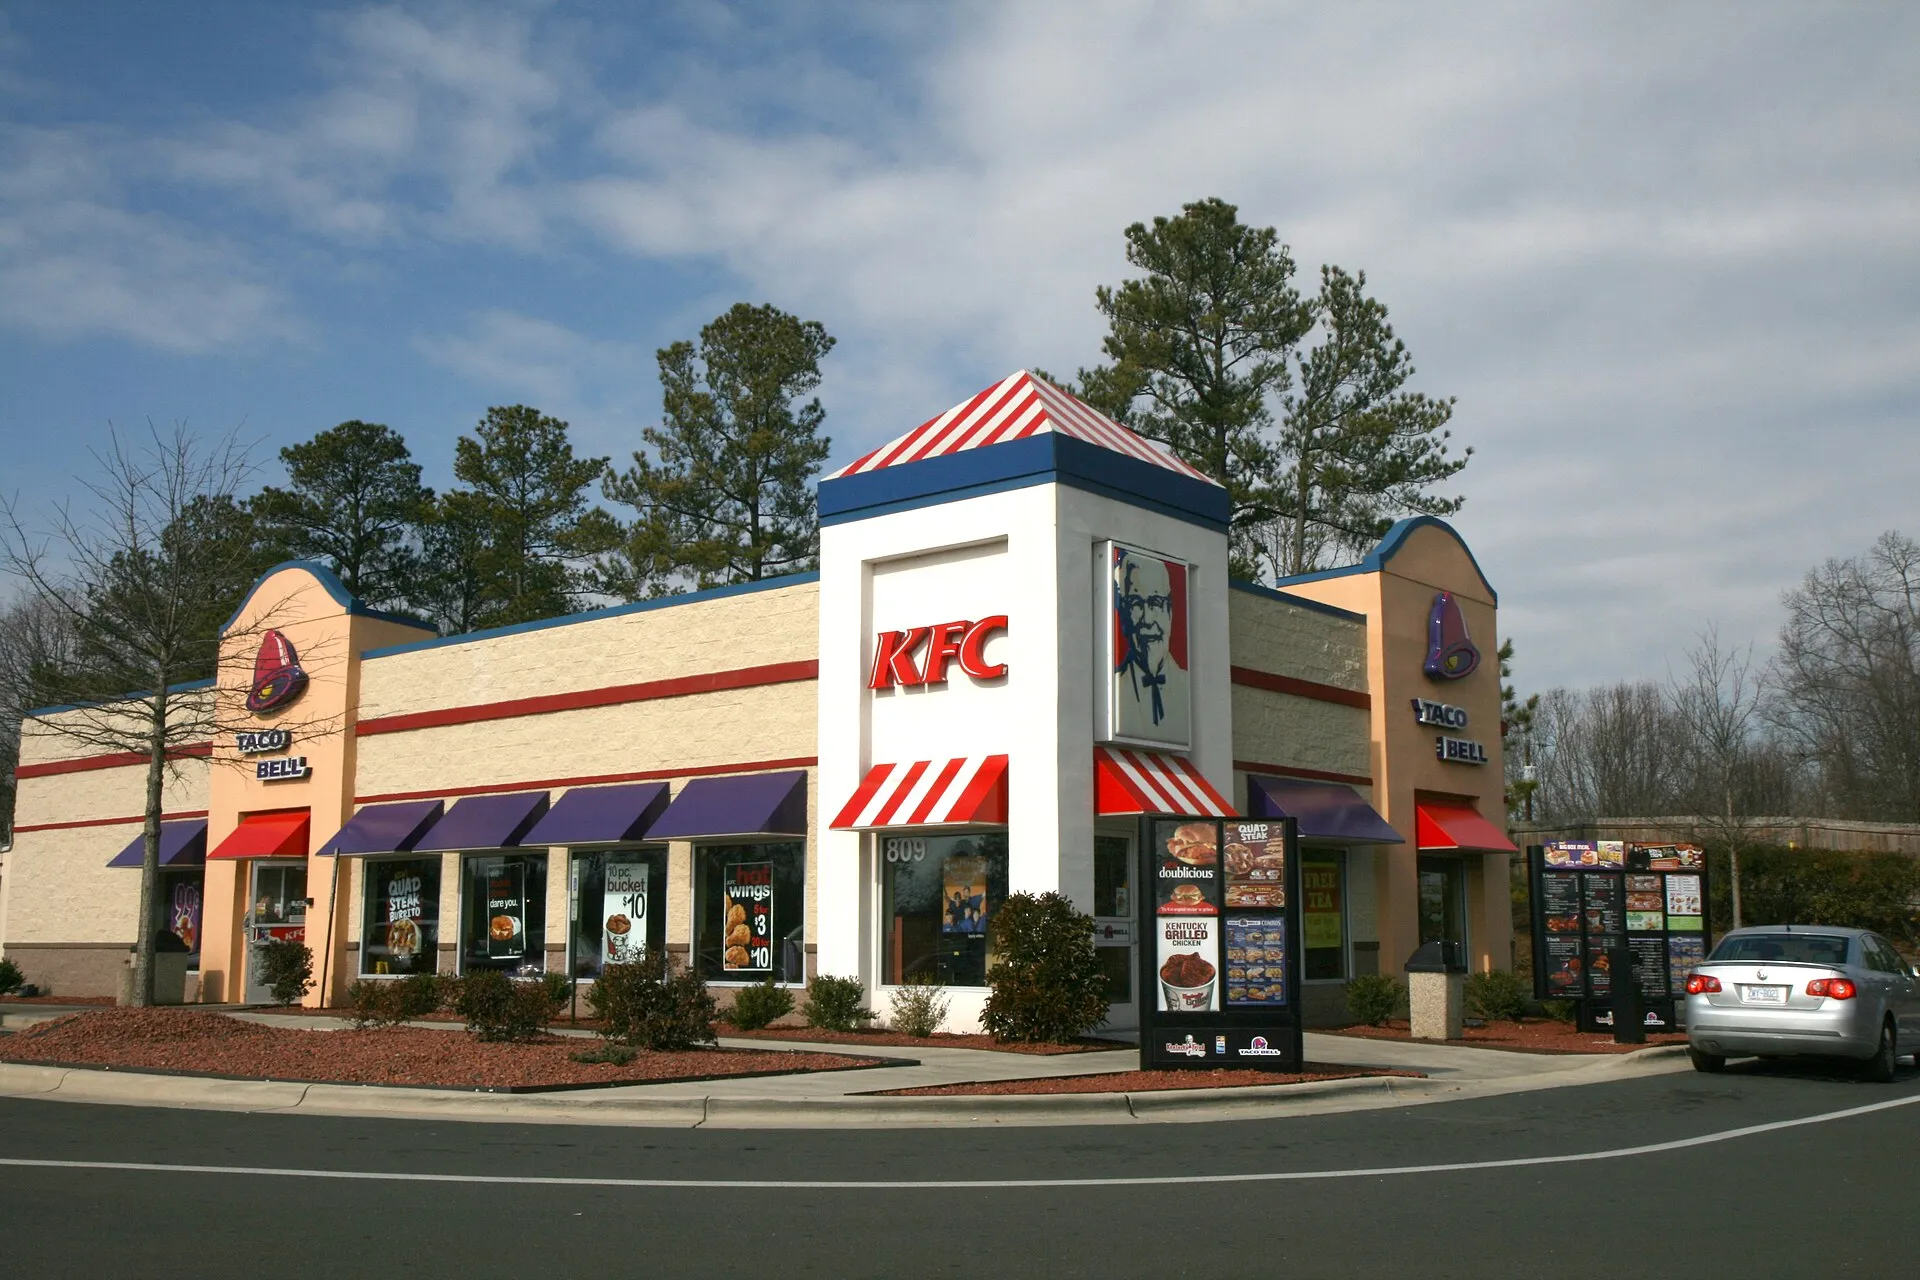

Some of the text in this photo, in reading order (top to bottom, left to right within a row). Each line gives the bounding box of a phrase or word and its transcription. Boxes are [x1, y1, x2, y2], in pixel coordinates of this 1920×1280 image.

[867, 615, 1009, 690] KFC
[1411, 697, 1468, 729] TACO
[236, 730, 291, 752] TACO
[1436, 736, 1488, 764] BELL
[256, 757, 313, 781] BELL
[1238, 824, 1268, 833] QUAD
[1240, 832, 1268, 841] STEAK
[886, 838, 926, 863] 809
[608, 865, 618, 877] 10
[736, 864, 769, 885] hot
[1159, 867, 1213, 879] doublicious
[389, 877, 421, 897] QUAD
[607, 878, 646, 892] bucket
[1304, 872, 1336, 889] FREE
[730, 885, 771, 901] wings
[1308, 892, 1333, 908] TEA
[389, 894, 420, 911] STEAK
[490, 899, 504, 908] dare
[622, 893, 646, 919] $10
[389, 907, 421, 922] BURRITO
[755, 914, 766, 935] $3
[1165, 922, 1208, 930] KENTUCKY
[1165, 931, 1208, 940] GRILLED
[751, 947, 769, 968] $10
